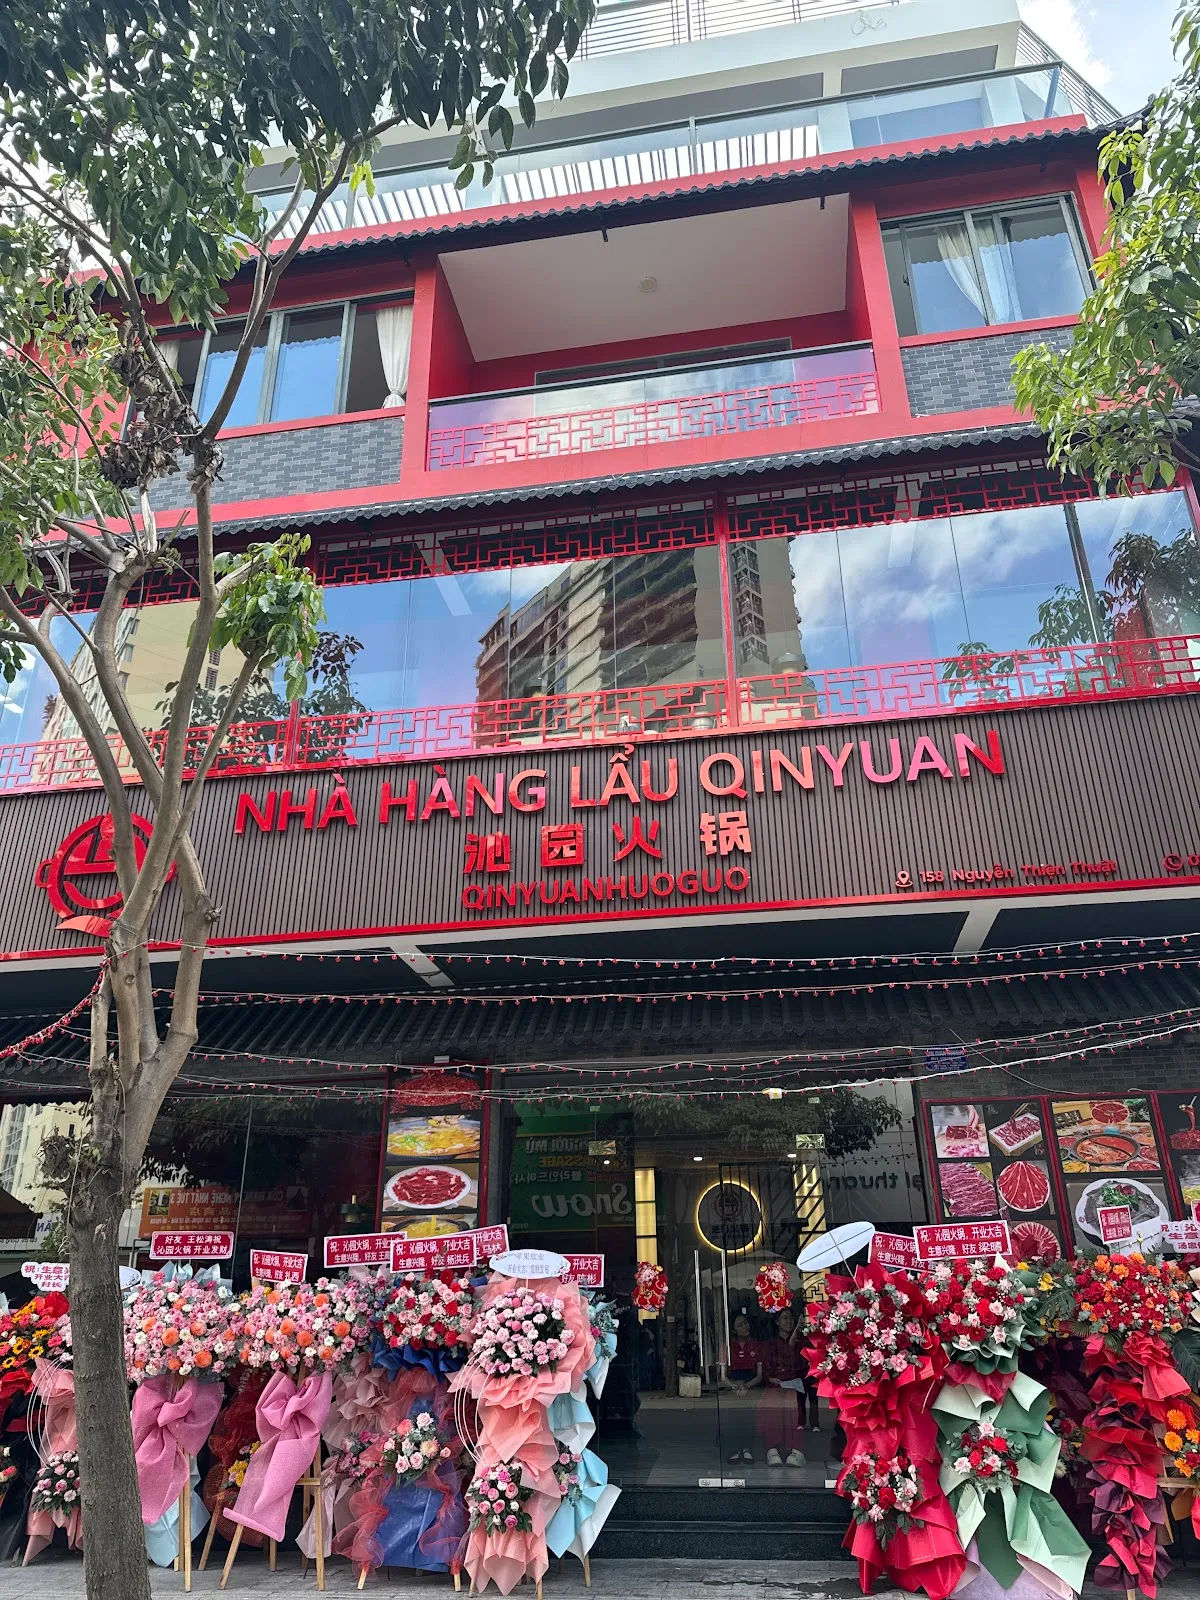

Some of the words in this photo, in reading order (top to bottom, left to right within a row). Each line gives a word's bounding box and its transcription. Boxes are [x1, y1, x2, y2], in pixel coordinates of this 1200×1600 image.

[234, 772, 358, 836] NHÀ
[379, 765, 548, 824] HÀNG
[569, 744, 679, 808] LẨU
[698, 729, 1005, 800] QINYUAN
[463, 810, 752, 874] 沁园火锅
[462, 866, 750, 911] QINYUANHUOGUO
[920, 870, 945, 883] 158
[952, 864, 1015, 884] Nguyễn
[1021, 863, 1066, 882] Thiện
[1071, 858, 1117, 877] Thuật
[156, 1245, 192, 1255] 沁园火锅
[193, 1245, 228, 1255] 开业发财
[165, 1235, 182, 1244] 好友
